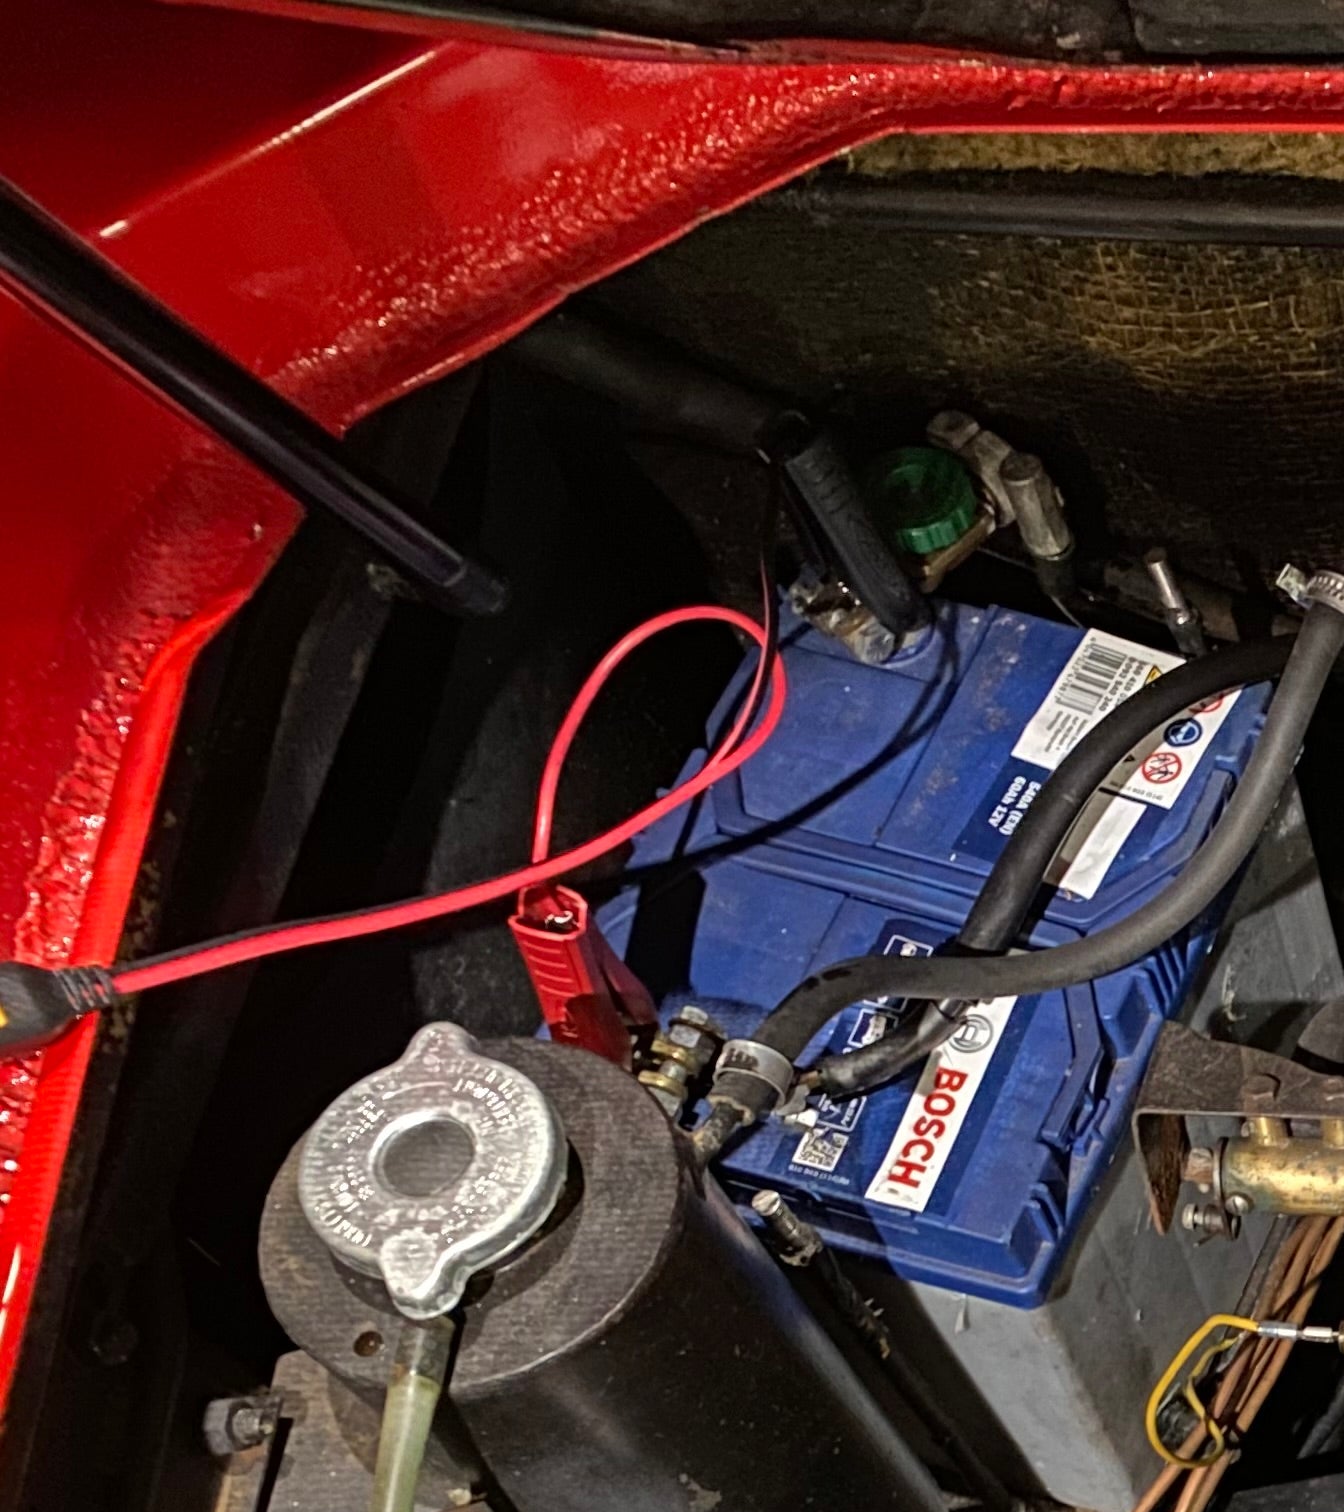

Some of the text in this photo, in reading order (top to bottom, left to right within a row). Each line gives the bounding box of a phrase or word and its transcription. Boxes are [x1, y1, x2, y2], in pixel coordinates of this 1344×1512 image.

[988, 775, 1027, 828] 60Ah 12V
[887, 1066, 969, 1189] BOSCH
